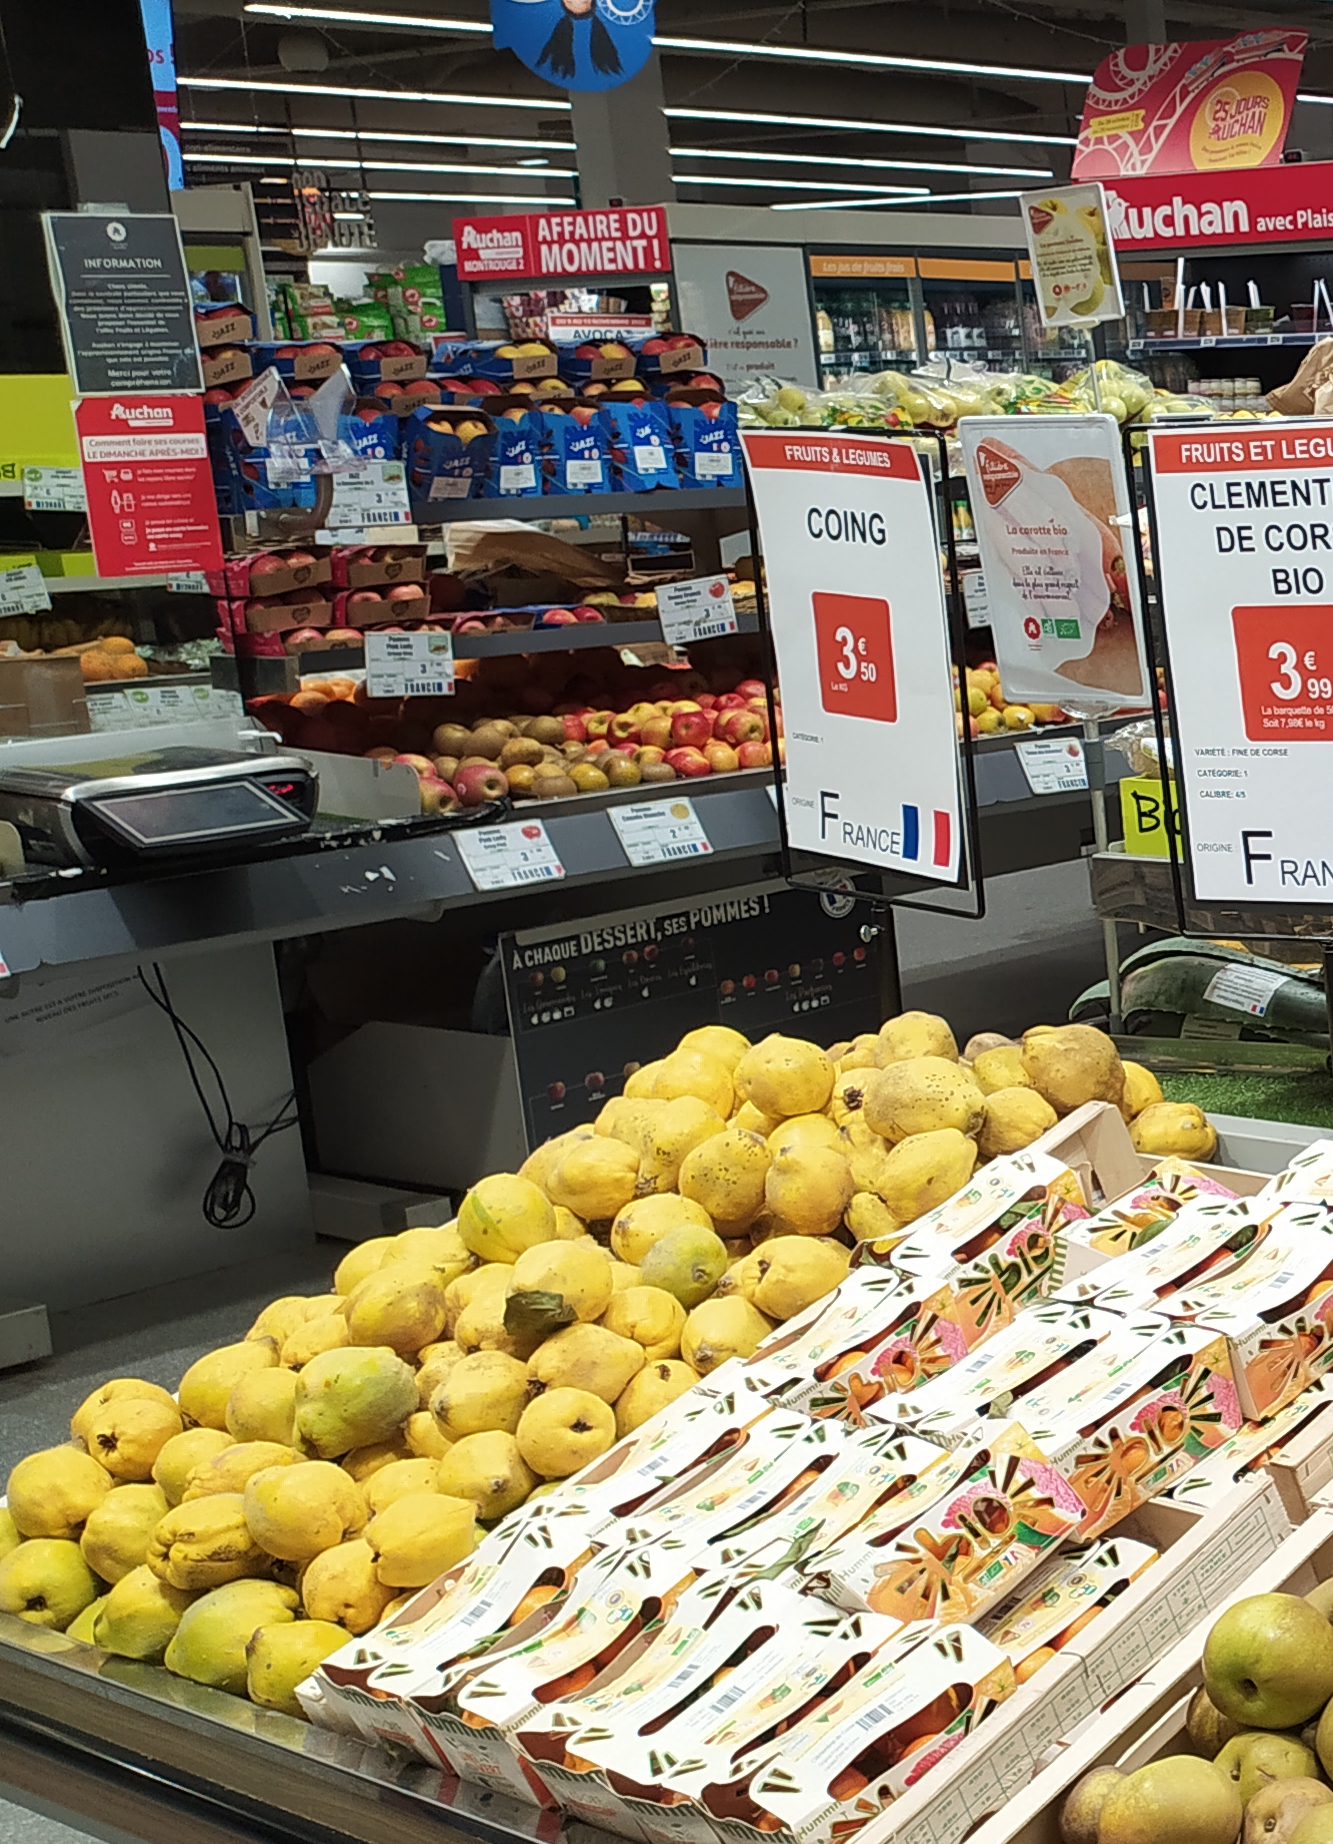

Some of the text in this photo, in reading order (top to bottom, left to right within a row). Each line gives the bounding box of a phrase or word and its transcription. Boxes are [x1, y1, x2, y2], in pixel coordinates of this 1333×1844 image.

[1213, 95, 1270, 122] 25 JOURS
[538, 211, 657, 241] AFFAIRE DU
[1256, 215, 1294, 233] avec
[461, 225, 522, 249] Auchan
[84, 258, 162, 269] INFORMATION
[464, 259, 517, 272] MONTROUGE
[540, 239, 661, 273] MOMENT !
[730, 340, 791, 350] responsable
[746, 362, 775, 370] produit
[110, 403, 172, 420] Auchan
[89, 439, 131, 448] Comment
[133, 438, 151, 446] faire
[1181, 442, 1244, 463] FRUITS
[1249, 440, 1275, 460] ET
[87, 451, 98, 459] LE
[100, 450, 148, 458] DIMANCHE
[785, 445, 891, 467] FRUITS & LEGUMES
[807, 507, 886, 545] COING
[1006, 525, 1068, 536] La carotte bio
[1216, 526, 1255, 553] DE
[1272, 567, 1324, 595] BIO
[835, 627, 876, 682] 3 50
[1268, 642, 1332, 700] 3 99
[1261, 706, 1272, 715] La
[1273, 705, 1312, 718] barquette
[1313, 705, 1324, 715] de
[1263, 718, 1325, 730] Soit le kg
[1195, 747, 1289, 757] VARIÉTÉ FINE DE CORSE
[820, 790, 900, 855] FRANCE
[1197, 843, 1233, 853] ORIGINE
[513, 894, 771, 970] À CHAQUE DESSERT, SES POMMES !
